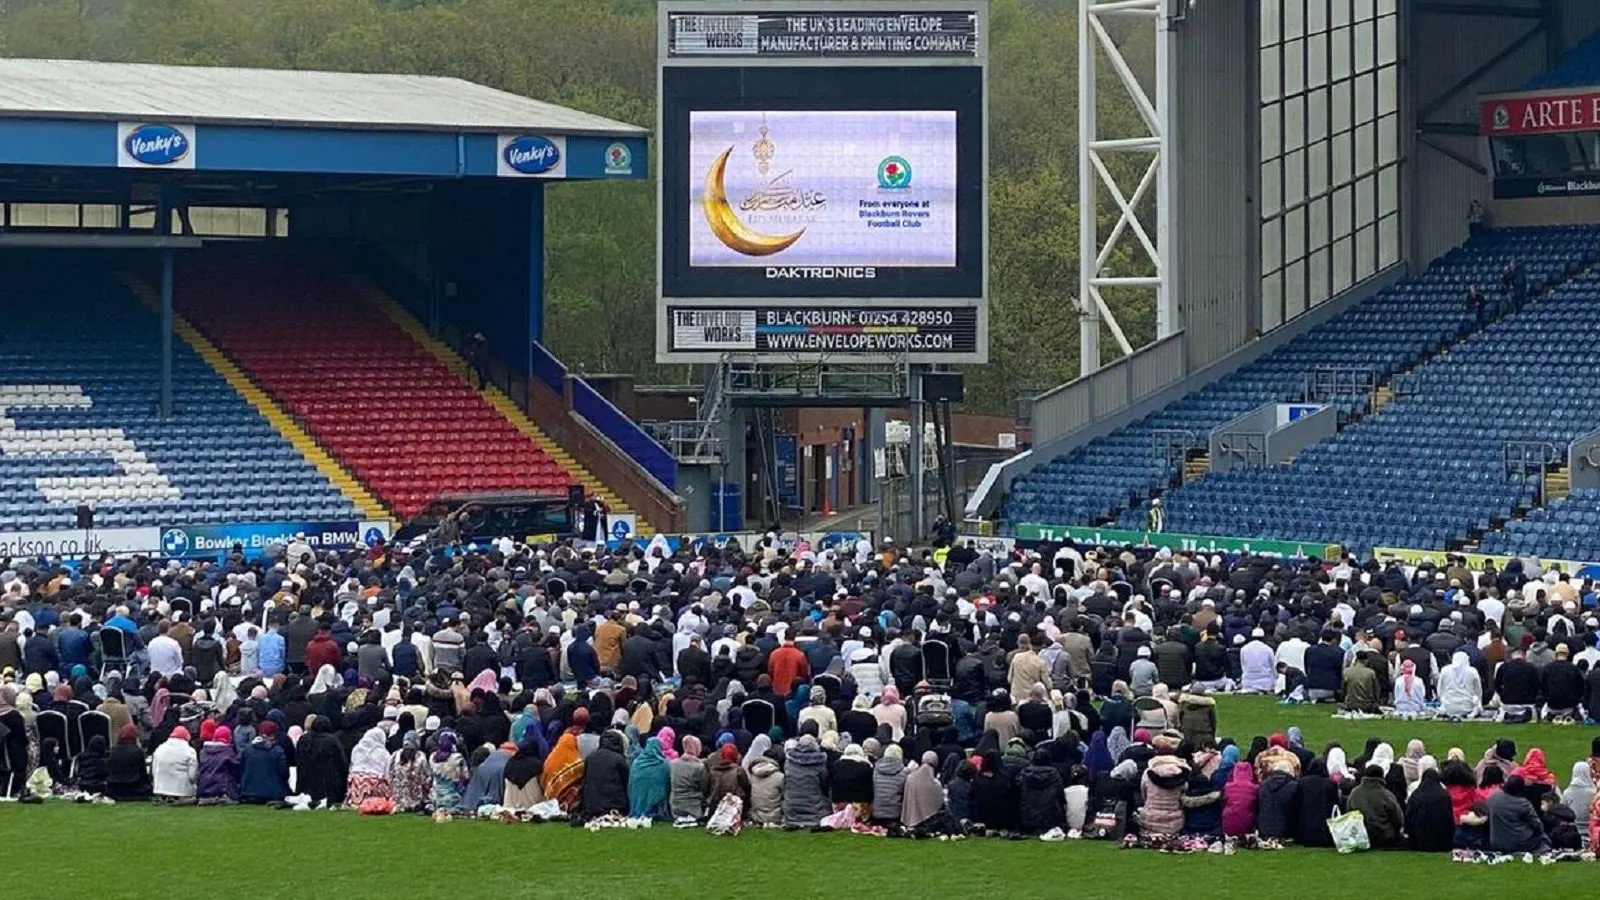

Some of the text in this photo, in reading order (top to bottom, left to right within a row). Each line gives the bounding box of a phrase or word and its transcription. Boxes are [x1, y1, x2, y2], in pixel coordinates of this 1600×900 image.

[677, 16, 697, 32] THE
[786, 16, 943, 32] THE UK'S LEADING ENVELOPE
[705, 33, 743, 48] WORKS
[761, 36, 968, 50] MANUFACTURER & PRINTING COMPANY
[1521, 99, 1583, 128] ARTE
[132, 133, 182, 156] Venky's
[509, 144, 554, 165] Venky's
[859, 200, 930, 211] From everyone at
[859, 209, 930, 218] Blackburn Rovers
[867, 219, 922, 228] Football Club
[765, 266, 876, 279] DAKTRONICS
[676, 311, 695, 327] THE
[766, 311, 953, 325] BLACKBURN: 01254 428950
[703, 327, 741, 342] WORKS
[766, 334, 953, 349] WWW.ENVELOPEWORKS.COM
[195, 535, 249, 550] Bowker
[251, 532, 320, 547] Blakbrn
[321, 530, 358, 546] BMW
